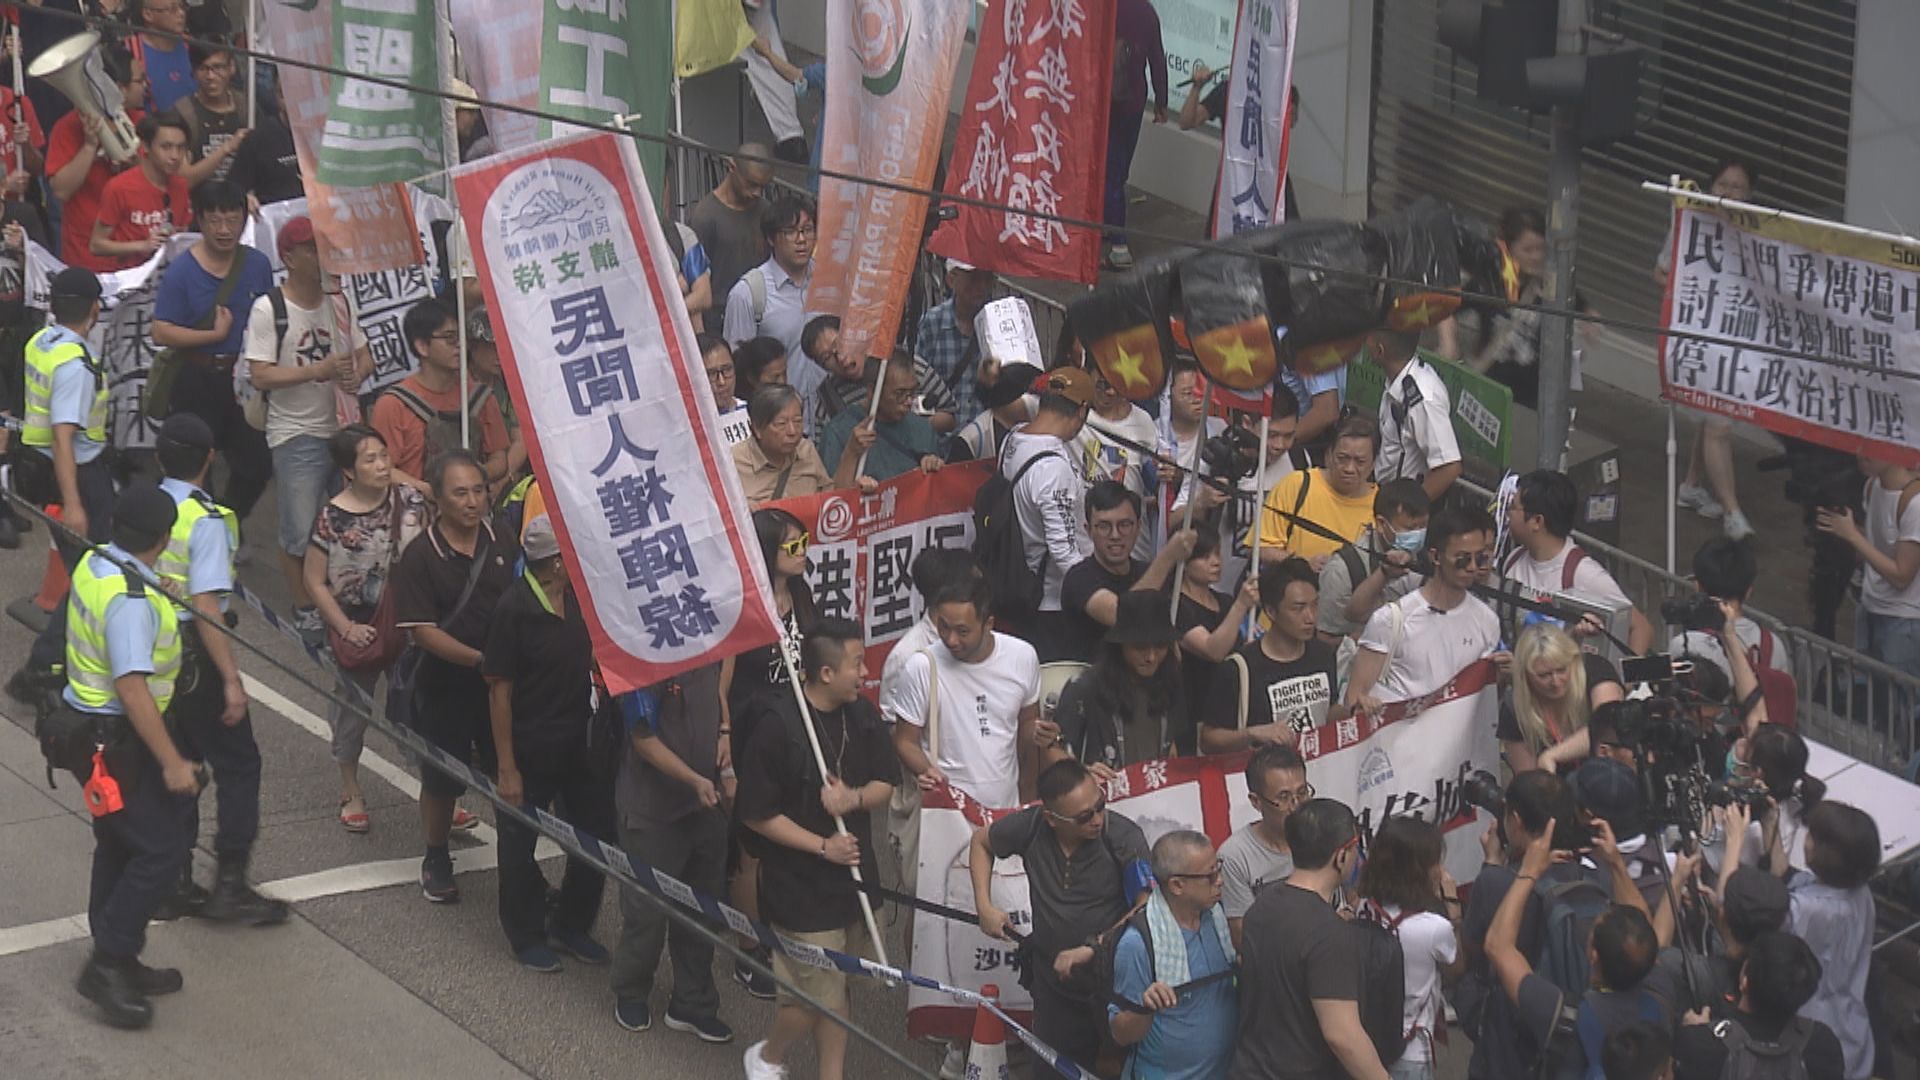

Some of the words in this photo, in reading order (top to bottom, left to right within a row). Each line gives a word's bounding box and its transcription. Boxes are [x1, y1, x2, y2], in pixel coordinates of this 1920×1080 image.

[1677, 276, 1898, 382] 討論港獨無罪
[1668, 338, 1906, 441] 停止政治打壓
[1271, 682, 1301, 699] FIGHT
[1303, 678, 1322, 691] FOR
[1273, 694, 1303, 710] HONG
[1305, 688, 1329, 704] KONG
